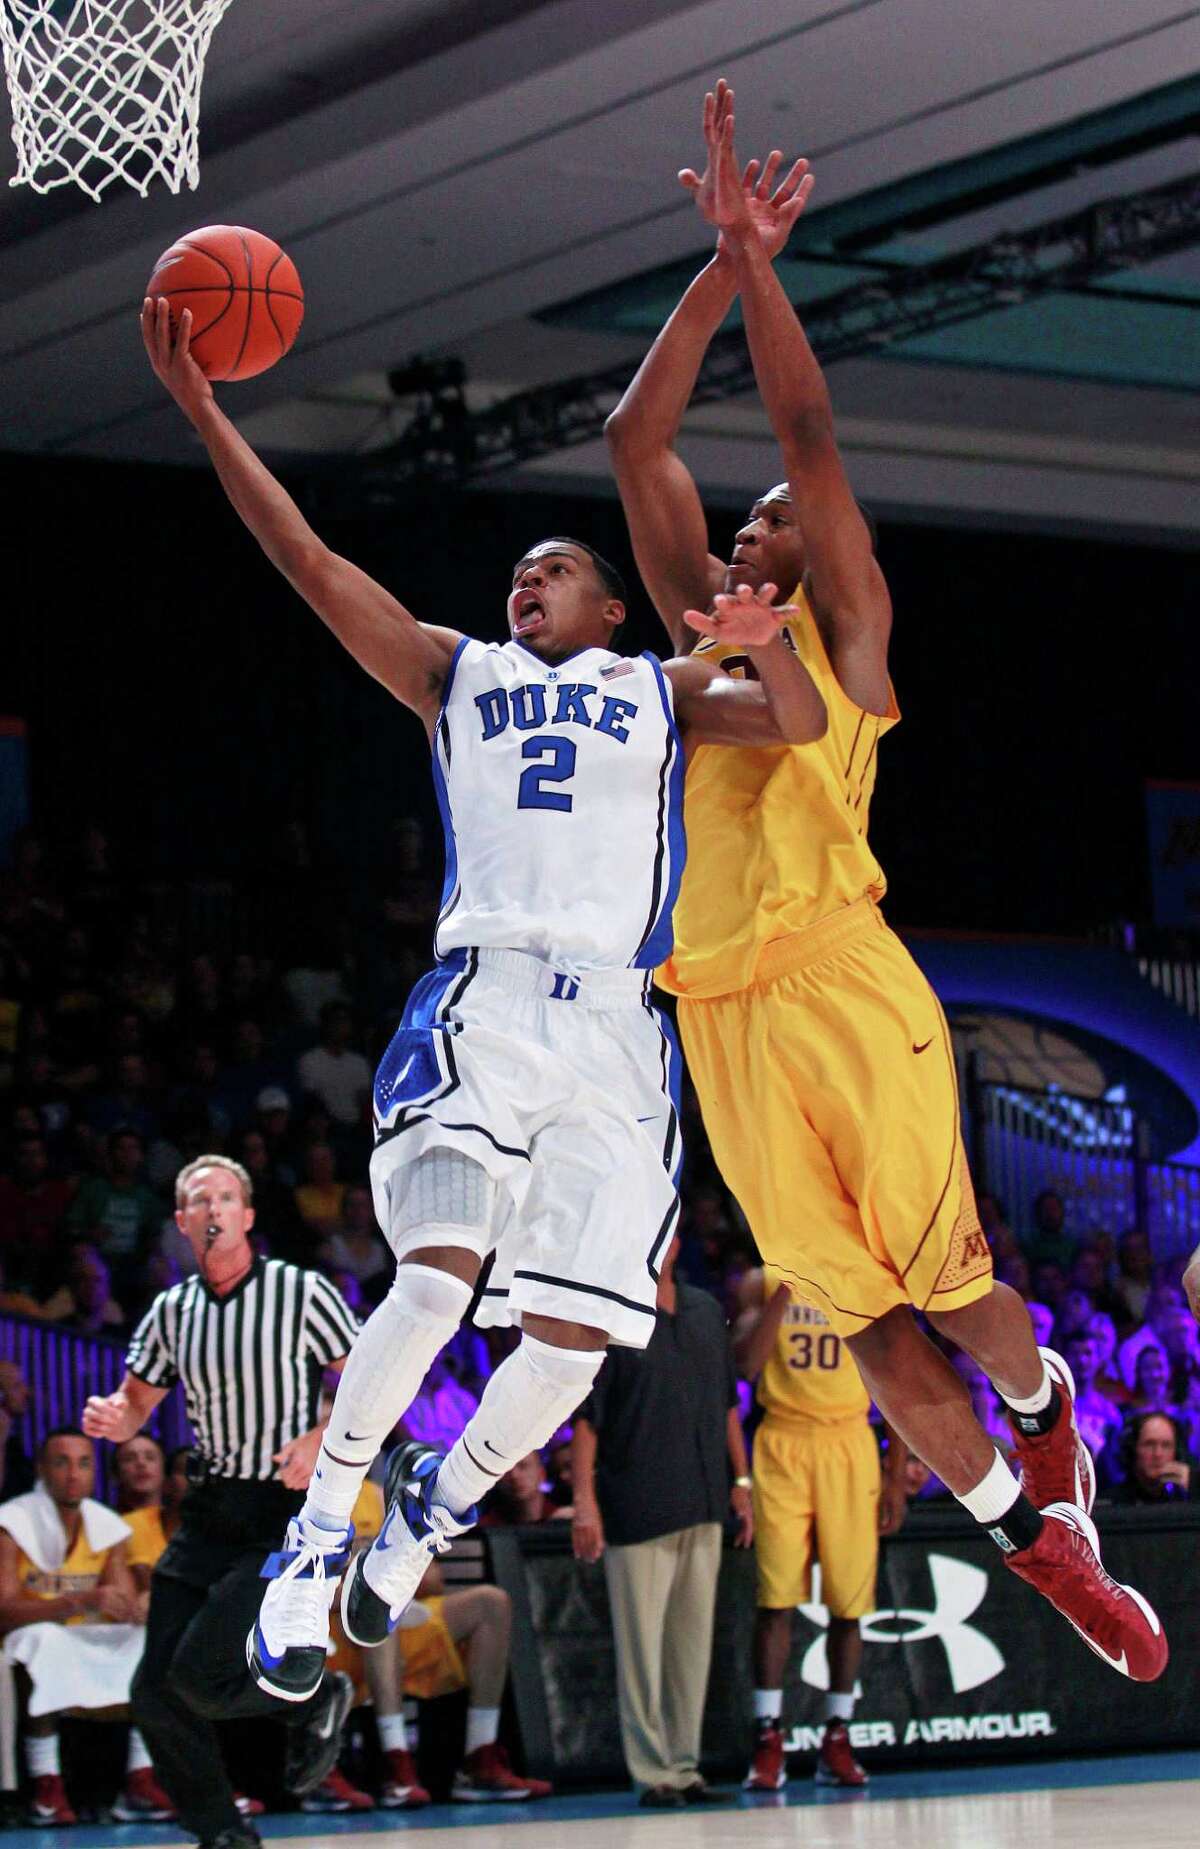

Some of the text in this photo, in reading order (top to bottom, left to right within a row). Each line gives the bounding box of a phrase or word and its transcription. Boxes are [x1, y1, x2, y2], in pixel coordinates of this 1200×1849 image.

[474, 683, 639, 745] DUKE
[517, 735, 577, 813] 2
[789, 1333, 841, 1370] 30
[782, 1711, 1054, 1752] UNER ARMOUR
